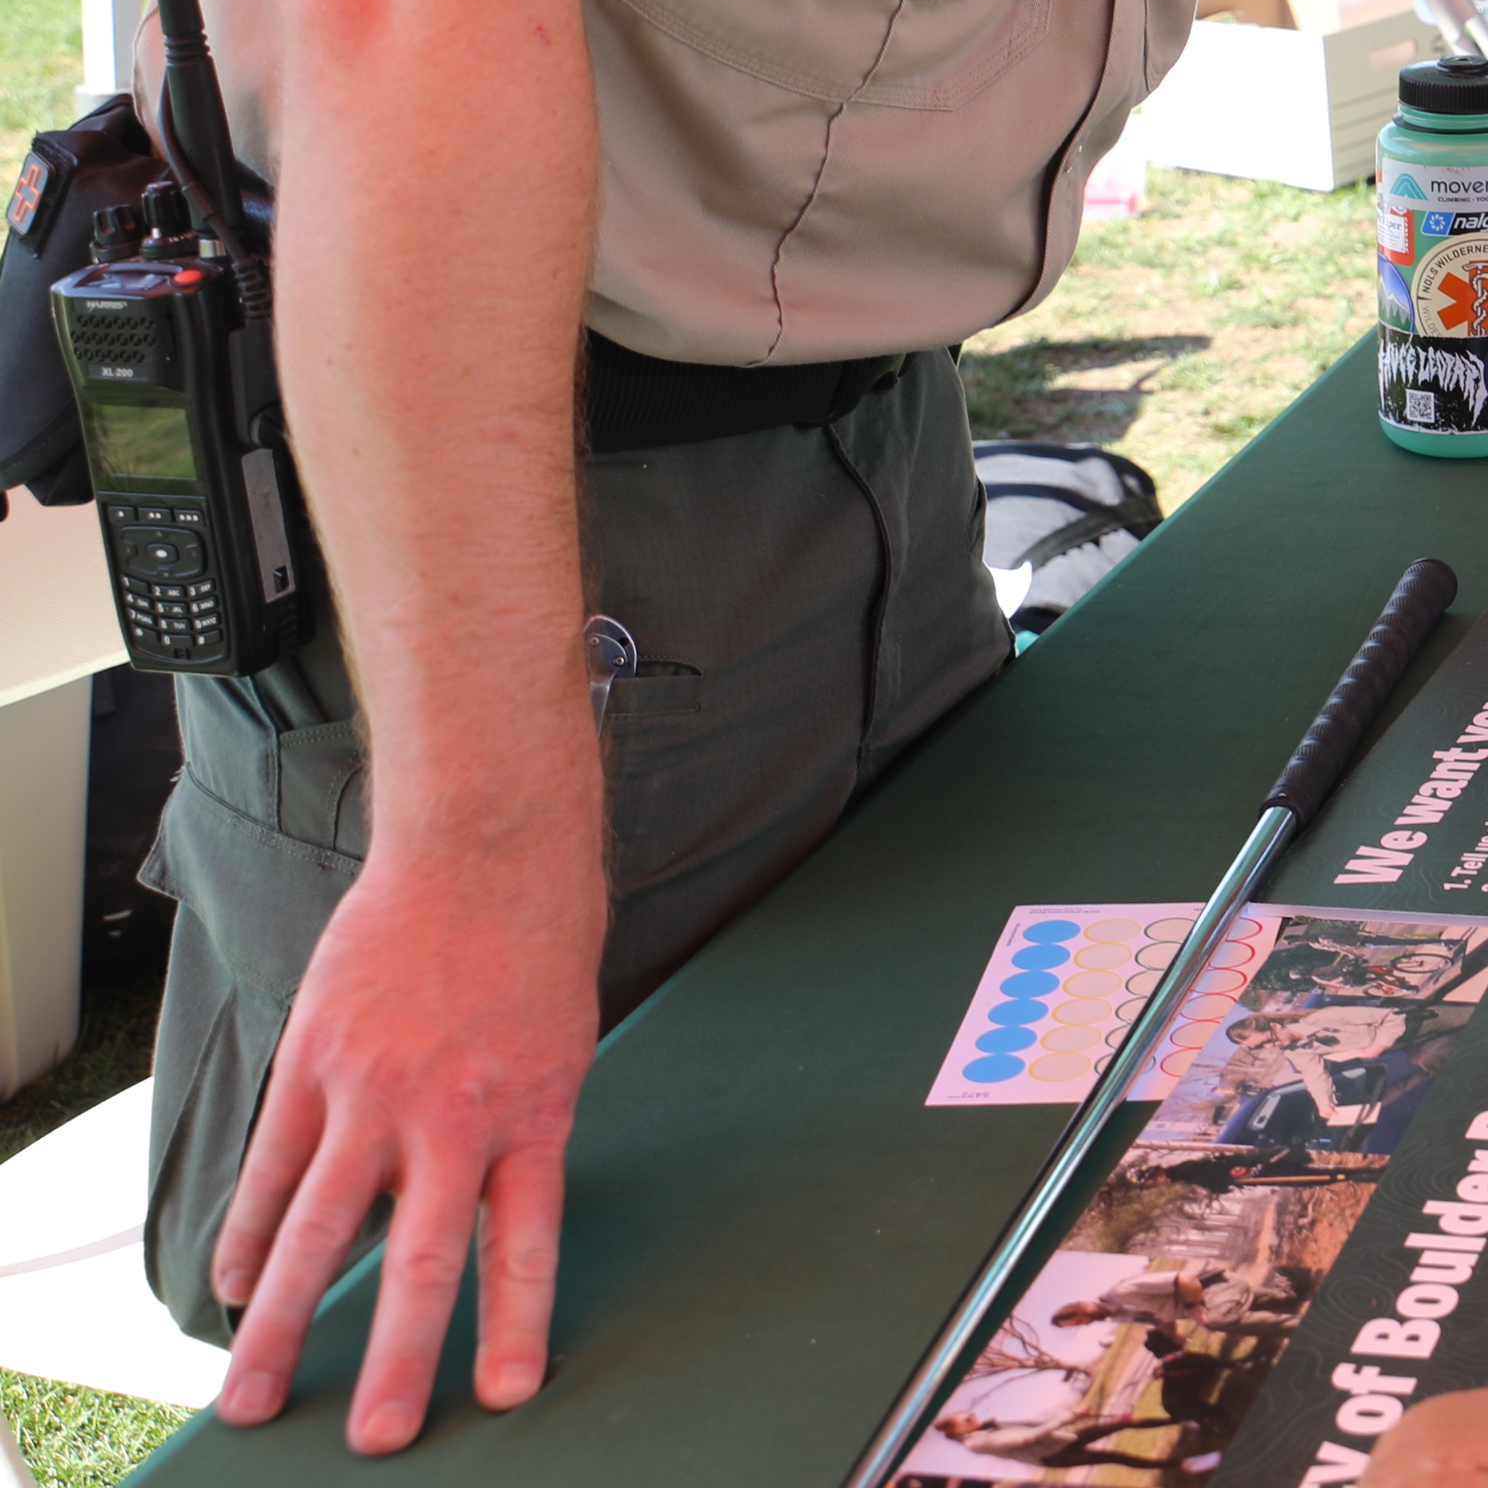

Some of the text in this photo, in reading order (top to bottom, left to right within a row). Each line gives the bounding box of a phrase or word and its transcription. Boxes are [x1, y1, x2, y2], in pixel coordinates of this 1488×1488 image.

[1422, 267, 1439, 294] NOLS
[1332, 830, 1428, 884] We
[1450, 852, 1488, 877] Tell
[1442, 878, 1472, 890] 1.
[1335, 1362, 1418, 1439] of
